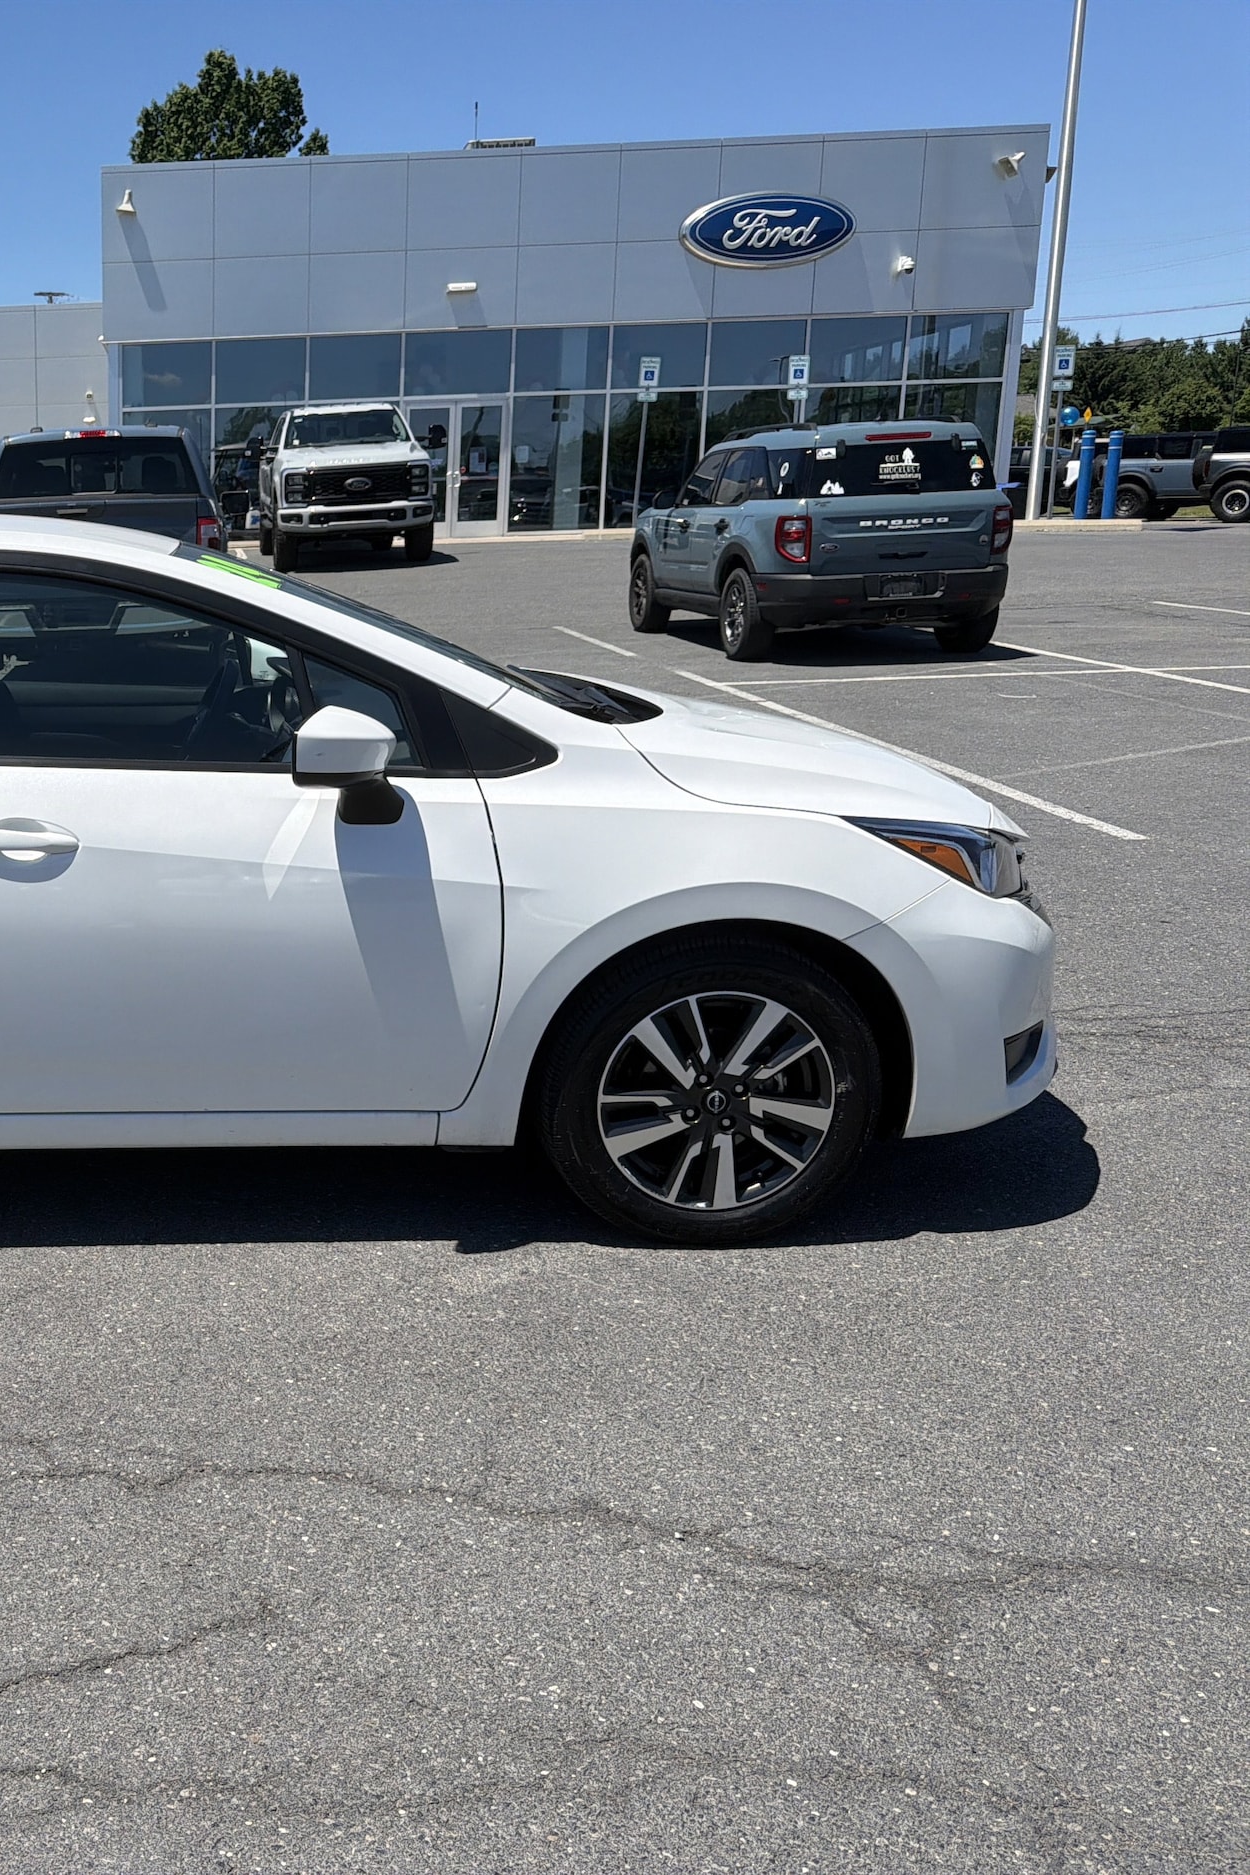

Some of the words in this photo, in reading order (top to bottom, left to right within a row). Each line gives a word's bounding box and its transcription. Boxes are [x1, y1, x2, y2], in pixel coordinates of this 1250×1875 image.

[722, 208, 821, 250] Ford
[884, 454, 900, 463] GOT
[859, 517, 949, 527] BRONCO
